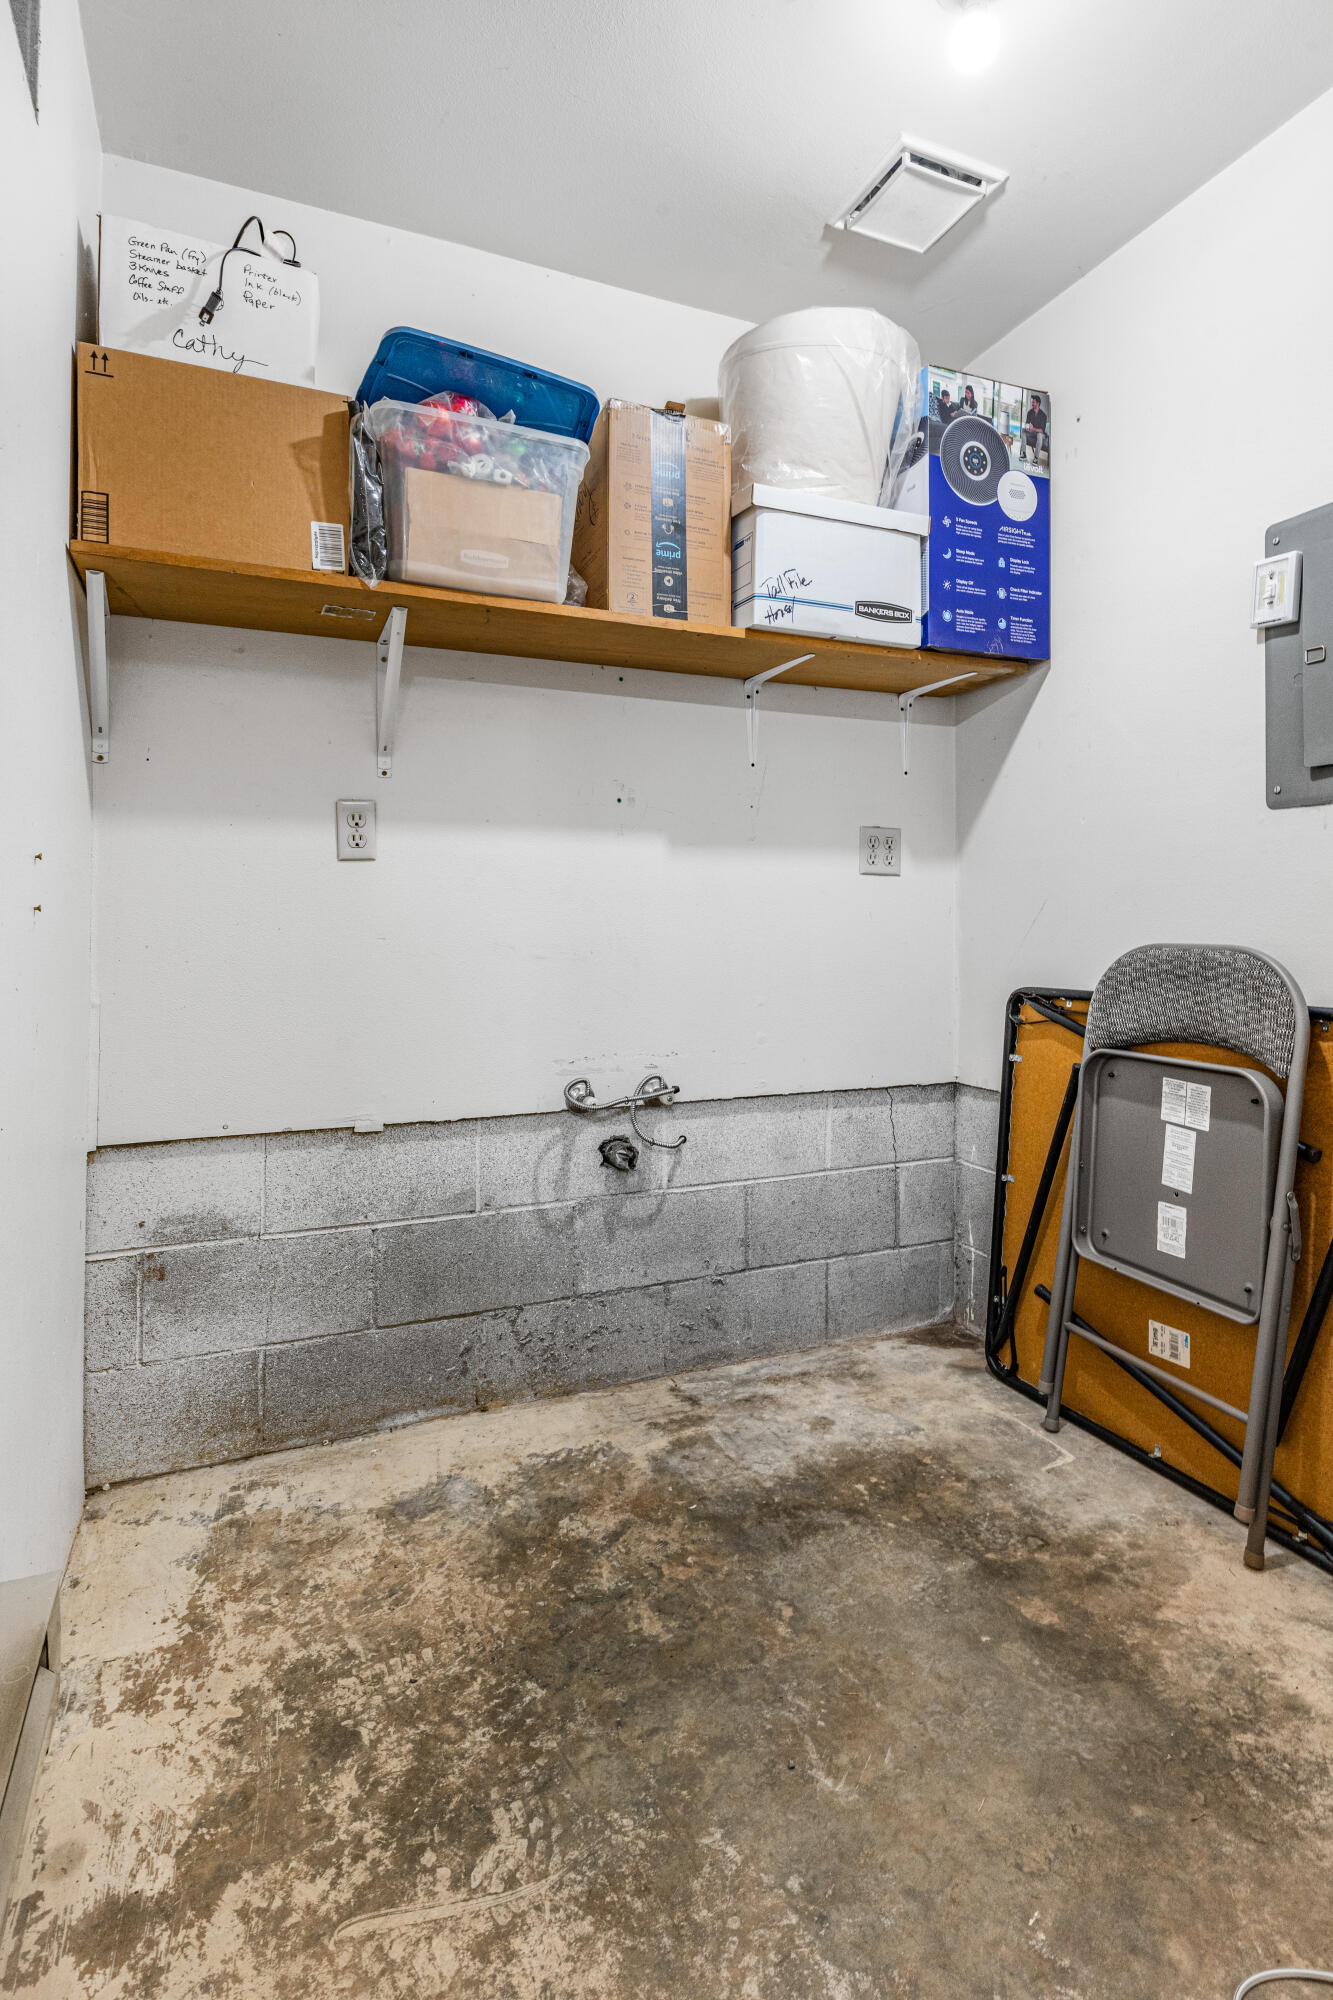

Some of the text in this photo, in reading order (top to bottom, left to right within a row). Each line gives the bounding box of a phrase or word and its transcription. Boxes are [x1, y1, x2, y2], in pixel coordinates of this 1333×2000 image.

[128, 236, 156, 249] Green
[129, 249, 208, 276] Steamer basket
[128, 274, 152, 289] Coffee
[243, 264, 278, 283] Printer
[243, 290, 276, 310] Paper
[172, 328, 269, 374] Cathy
[655, 548, 682, 560] prime
[858, 605, 910, 620] BANKERS BOX
